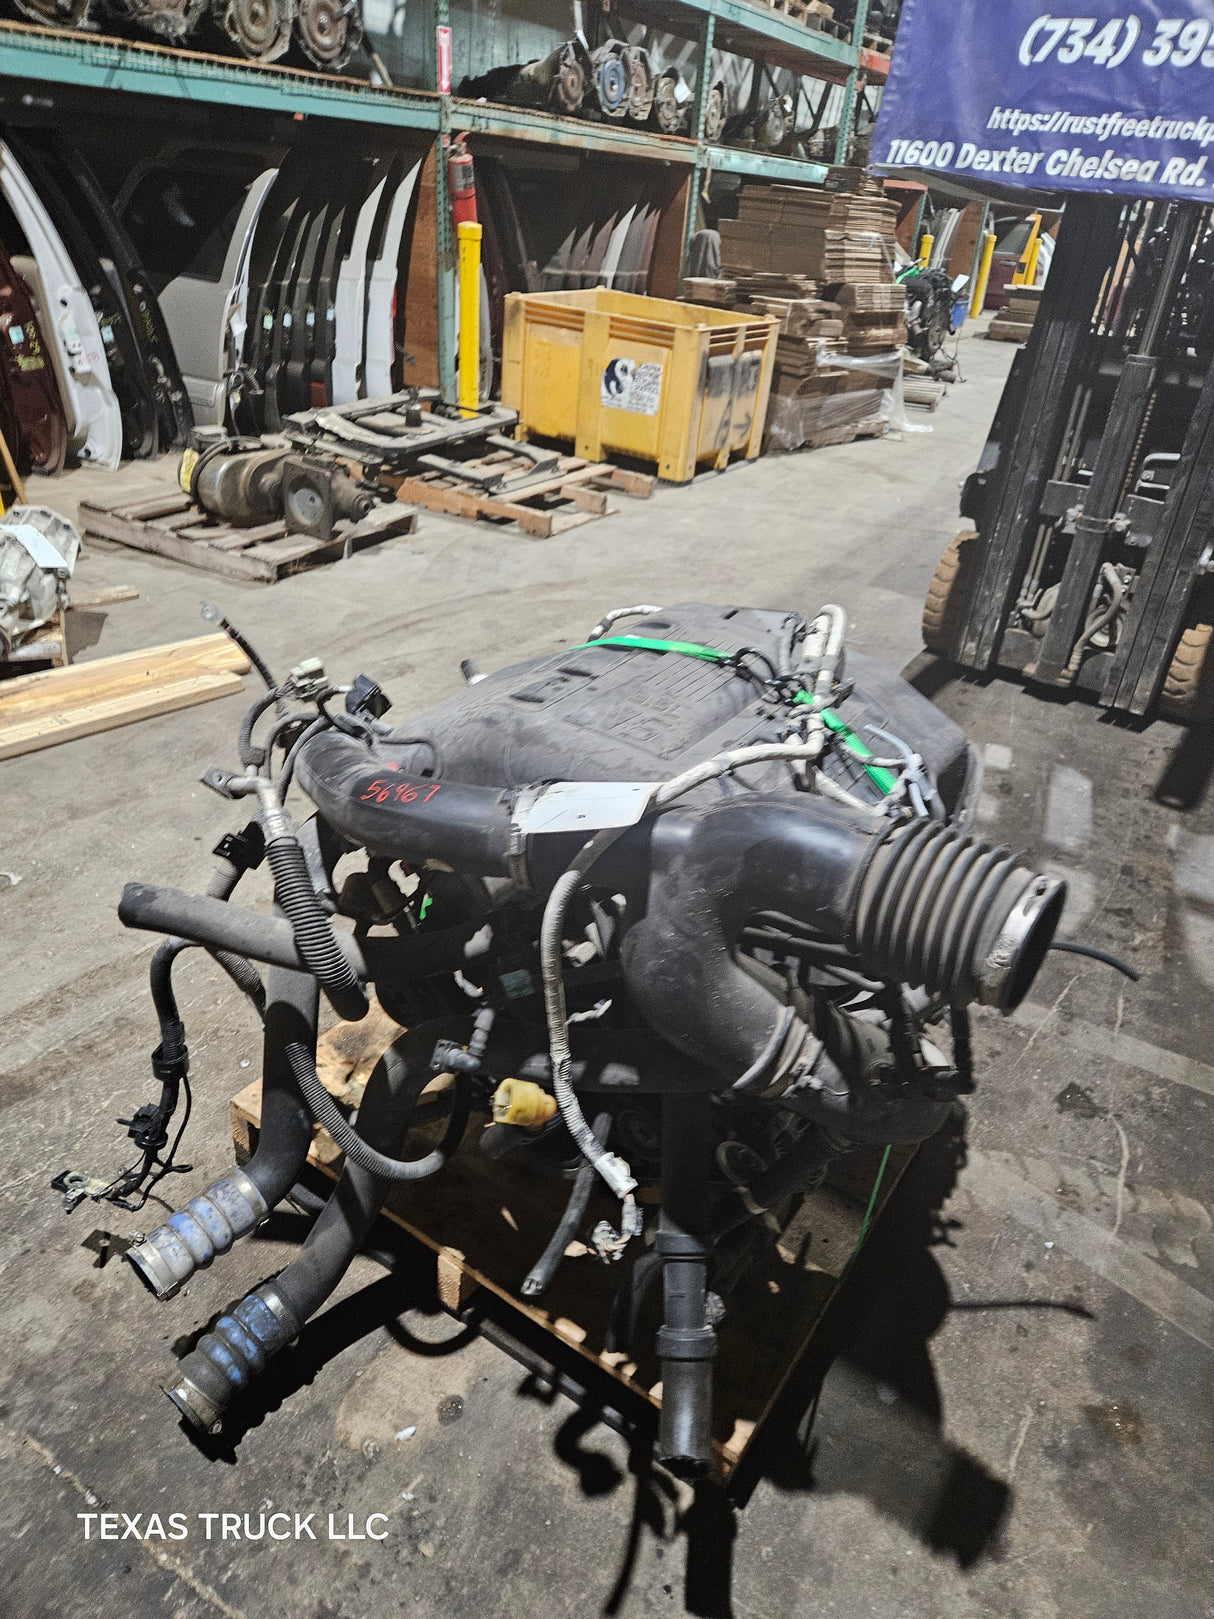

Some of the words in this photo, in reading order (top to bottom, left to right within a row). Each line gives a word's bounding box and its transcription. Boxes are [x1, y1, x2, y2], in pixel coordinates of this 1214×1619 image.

[1018, 14, 1141, 69] (734)
[886, 139, 954, 168] 11600
[954, 142, 1045, 175] Dexter
[1045, 147, 1160, 183] Chelsea
[1159, 155, 1208, 187] Rd.
